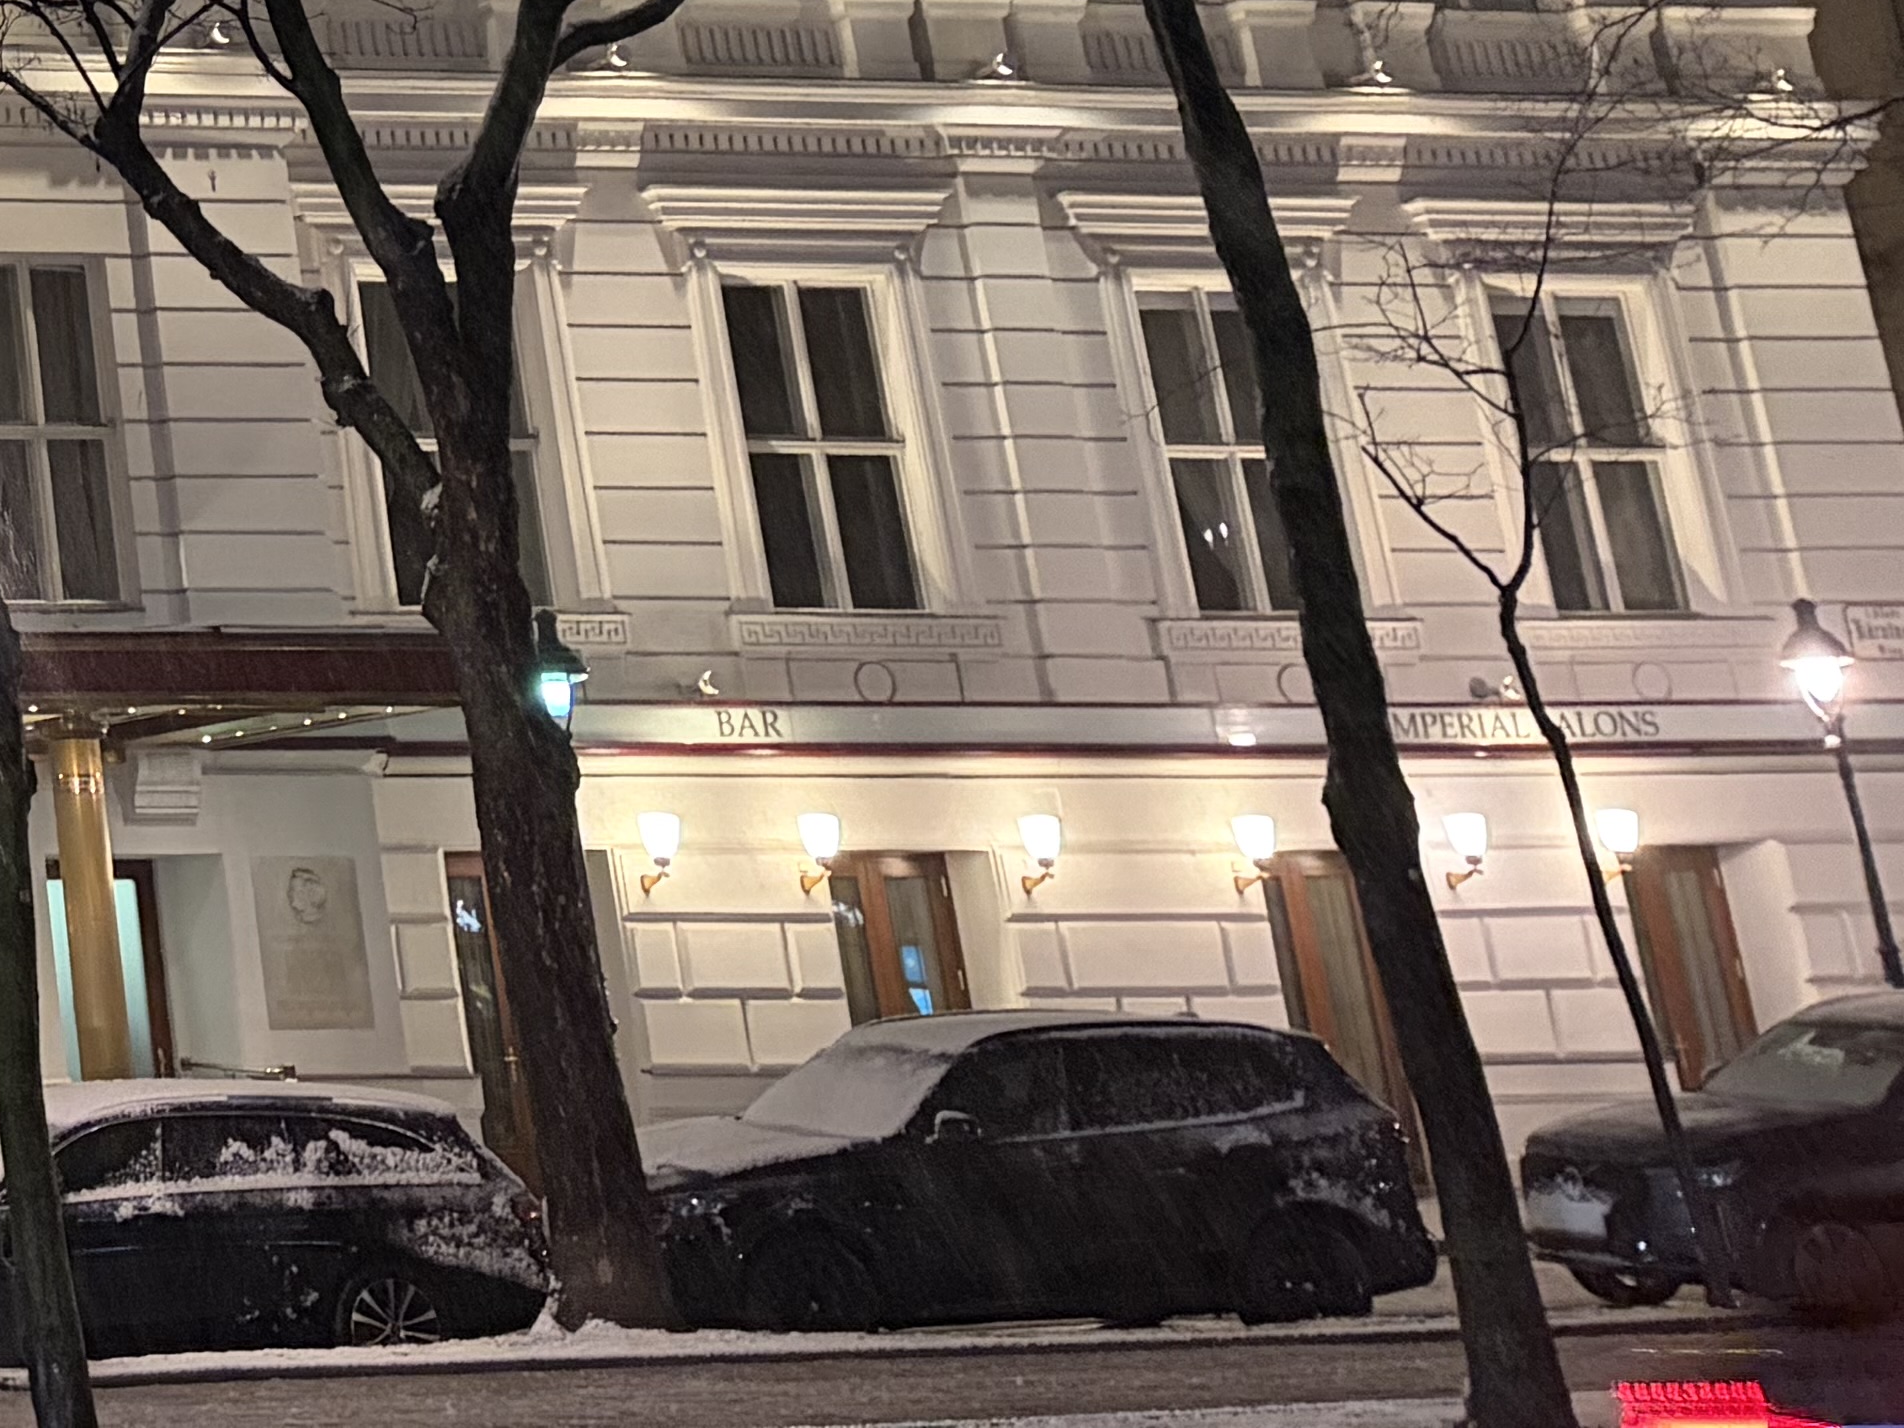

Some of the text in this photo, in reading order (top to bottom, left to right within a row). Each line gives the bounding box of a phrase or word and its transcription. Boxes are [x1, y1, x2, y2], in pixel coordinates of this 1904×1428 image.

[714, 709, 785, 738] BAR
[1392, 709, 1661, 740] MPERIAL ALONS
